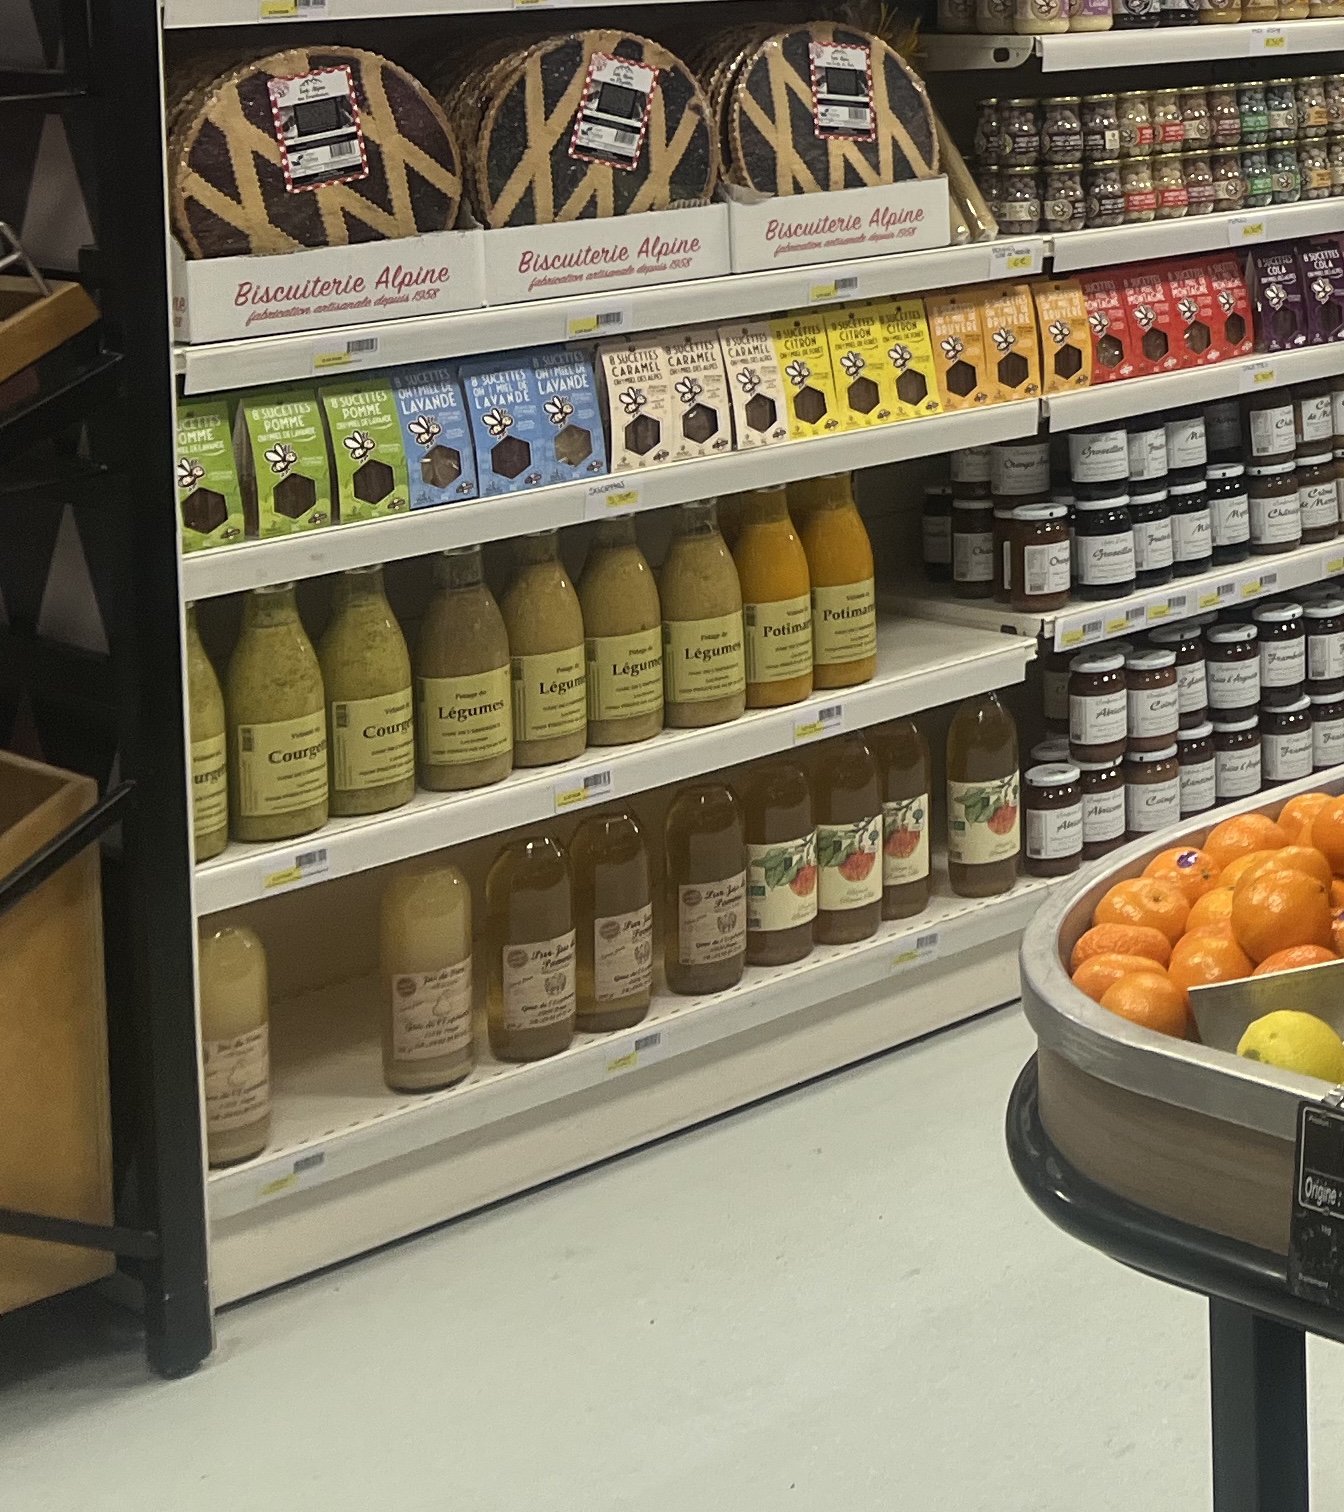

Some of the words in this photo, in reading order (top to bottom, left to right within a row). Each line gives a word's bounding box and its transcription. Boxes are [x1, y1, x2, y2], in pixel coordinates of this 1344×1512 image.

[765, 214, 861, 241] Biscuiterie
[869, 206, 924, 231] Alpine
[518, 245, 629, 274] Biscuiterie
[637, 235, 701, 263] Alpine
[1267, 264, 1287, 276] COLA
[1313, 260, 1334, 270] COLA
[527, 272, 584, 292] fabrication
[586, 264, 634, 281] artisanale
[636, 262, 667, 275] depuis
[669, 257, 692, 270] 1958
[234, 275, 365, 308] Biscuiterie
[375, 265, 450, 294] Alpine
[245, 303, 311, 327] fabrication
[312, 296, 371, 313] artisanale
[374, 293, 409, 309] depuis
[411, 288, 440, 303] 1958
[839, 328, 872, 342] CITRON
[886, 321, 918, 334] CITRON
[727, 344, 770, 358] CARAMEL
[784, 336, 817, 350] CITRON
[616, 350, 659, 364] SUCETTES
[667, 352, 716, 367] CARAMEL
[612, 363, 660, 377] CARAMEL
[538, 374, 589, 395] LAVANDE
[339, 391, 388, 407] SUCETTES
[400, 392, 457, 416] LAVANDE
[475, 391, 531, 410] LAVANDE
[261, 402, 311, 420] SUCETTES
[341, 402, 382, 420] POMME
[263, 414, 305, 432] POMME
[178, 428, 213, 445] OMME
[438, 699, 504, 722] Légumes
